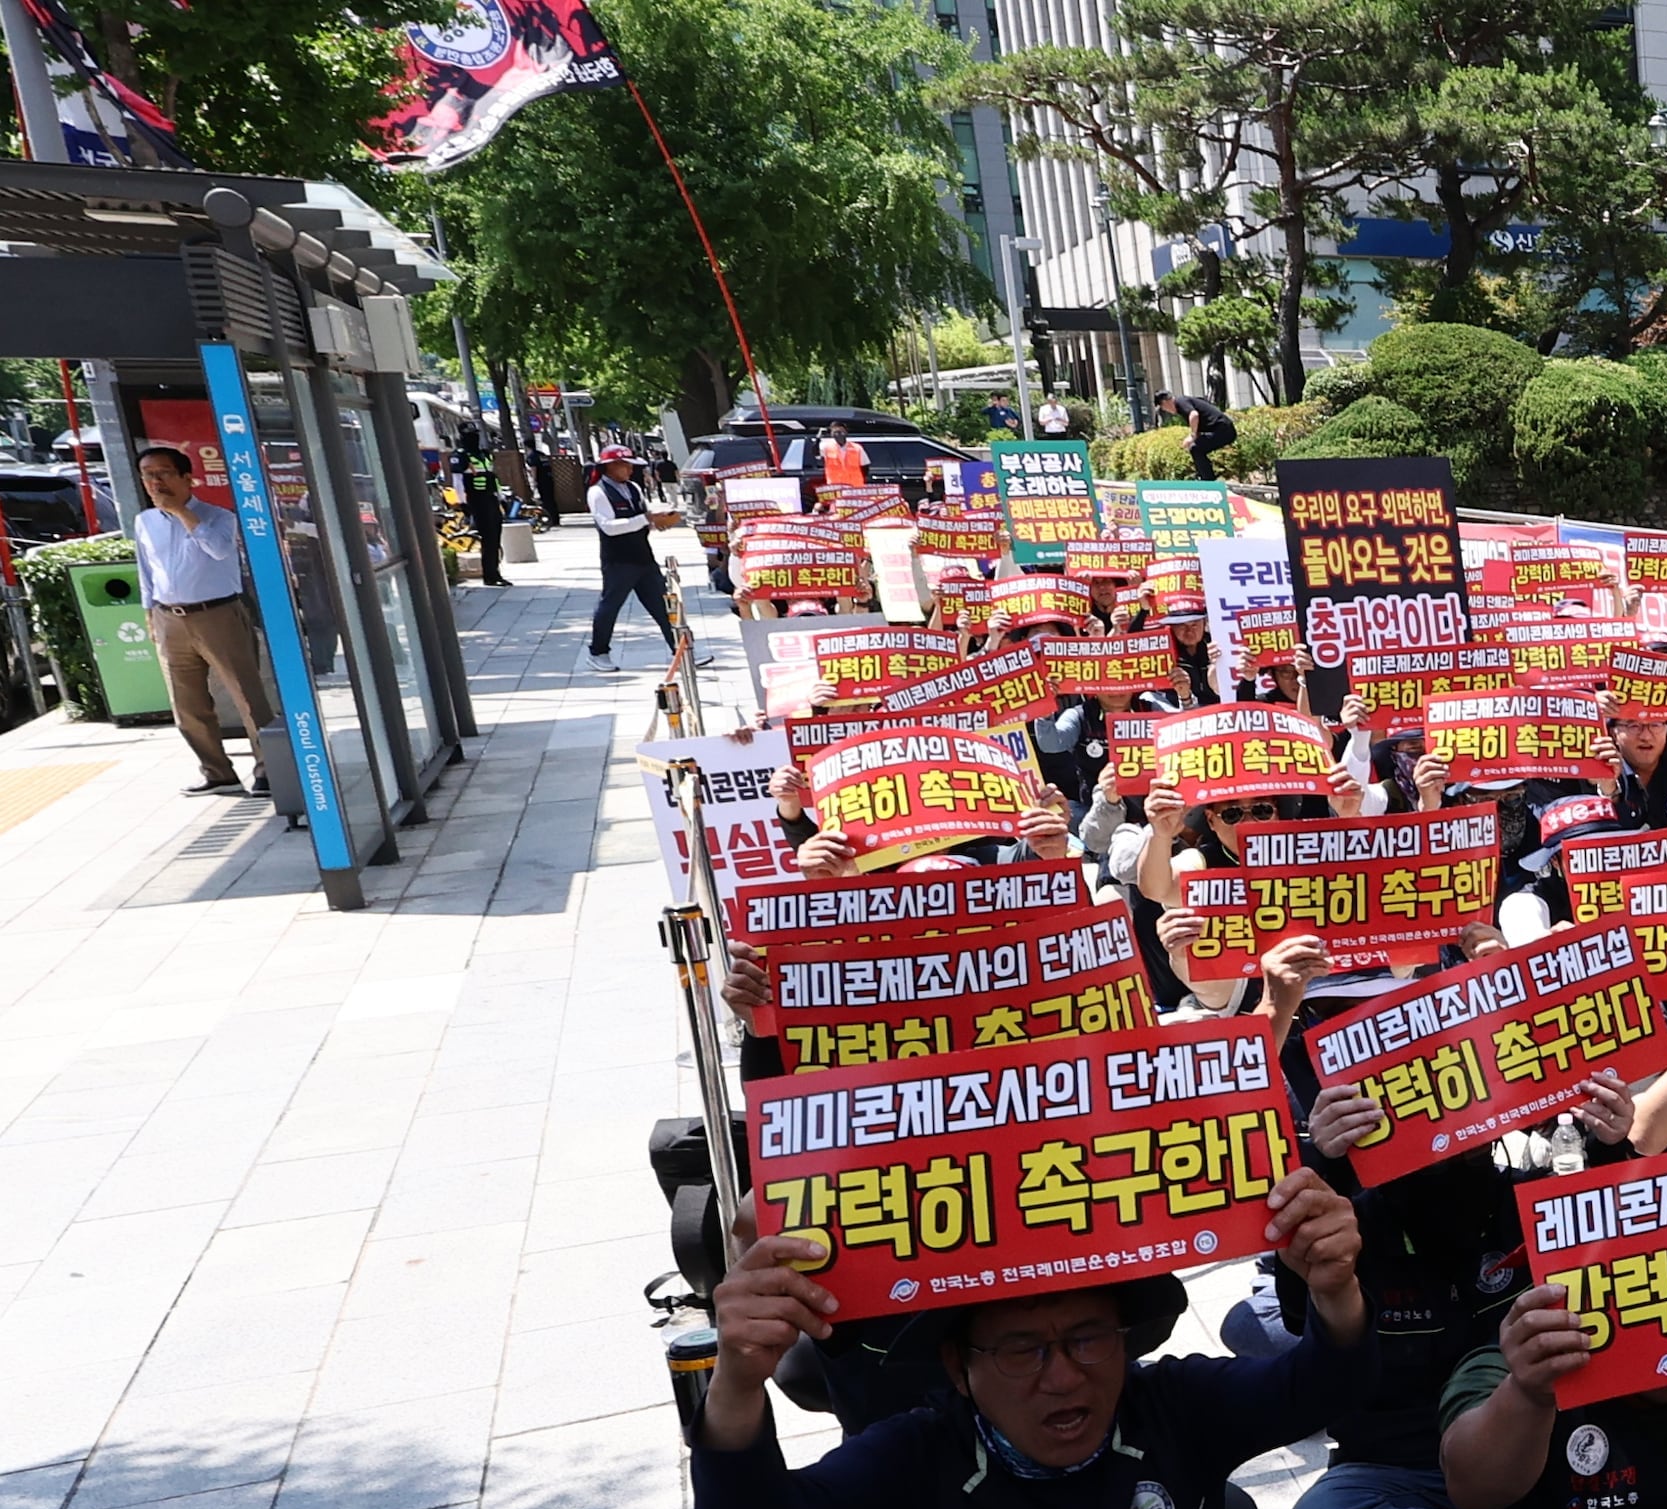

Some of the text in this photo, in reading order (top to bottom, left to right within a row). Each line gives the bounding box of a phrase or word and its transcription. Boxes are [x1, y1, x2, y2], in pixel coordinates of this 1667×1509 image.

[1000, 453, 1082, 472] 부실공사
[232, 451, 268, 536] 서울세관
[1006, 476, 1088, 496] 초래하는
[1008, 500, 1093, 520] 레미콘덤핑요구
[1292, 490, 1450, 530] 우리의 요구 외면하면,
[1014, 521, 1097, 542] 척결하자
[1302, 536, 1401, 585] 돌아오는
[1406, 536, 1454, 582] 것은
[816, 632, 957, 655] 레미콘제조사의 단체교섭
[1044, 635, 1169, 656] 레미콘제조사의 단체교섭
[1244, 629, 1295, 655] 강력히
[1309, 595, 1464, 664] 총파업이다
[1506, 622, 1636, 642] 레미콘제조사의 단체교섭
[820, 655, 881, 685] 강력히
[1046, 654, 1174, 684] 강력히 촉구한다
[1352, 648, 1510, 676] 레미콘제조사의 단체교섭
[1512, 646, 1566, 674] 강력히
[884, 650, 1034, 714] 레미콘제조사의 단체교섭
[1354, 678, 1423, 712] 강력히
[1158, 710, 1268, 749] 레미콘제조사의
[1272, 710, 1324, 743] 단체교섭
[1428, 695, 1598, 724] 레미콘제조사의 단체교섭
[295, 712, 327, 811] Seoul Customs
[1158, 742, 1234, 787] 강력히
[1242, 738, 1332, 775] 촉구한다
[1429, 723, 1602, 762] 강력히 촉구한다
[811, 735, 1021, 791] 레미콘제조사의 단체교섭
[816, 769, 1030, 837] 강력히 촉구한다
[1245, 814, 1496, 867] 레미콘제조사의 단체교섭
[747, 871, 1076, 932] 레미콘제조사의 단체교섭
[1250, 874, 1366, 931] 강력히
[1380, 856, 1497, 918] 촉구한다
[779, 948, 1028, 1009] 레미콘제조사의
[1039, 917, 1134, 982] 단체교섭
[1317, 926, 1634, 1076] 레미콘제조사의 단체교섭
[1494, 977, 1655, 1083] 촉구한다
[760, 1035, 1267, 1159] 레미콘제조사의 단체교섭
[765, 1109, 1290, 1273] 강력히 촉구한다
[928, 1237, 1188, 1295] 한국노총 전국레미콘운송노동조합
[1586, 1491, 1639, 1509] 한국노총
